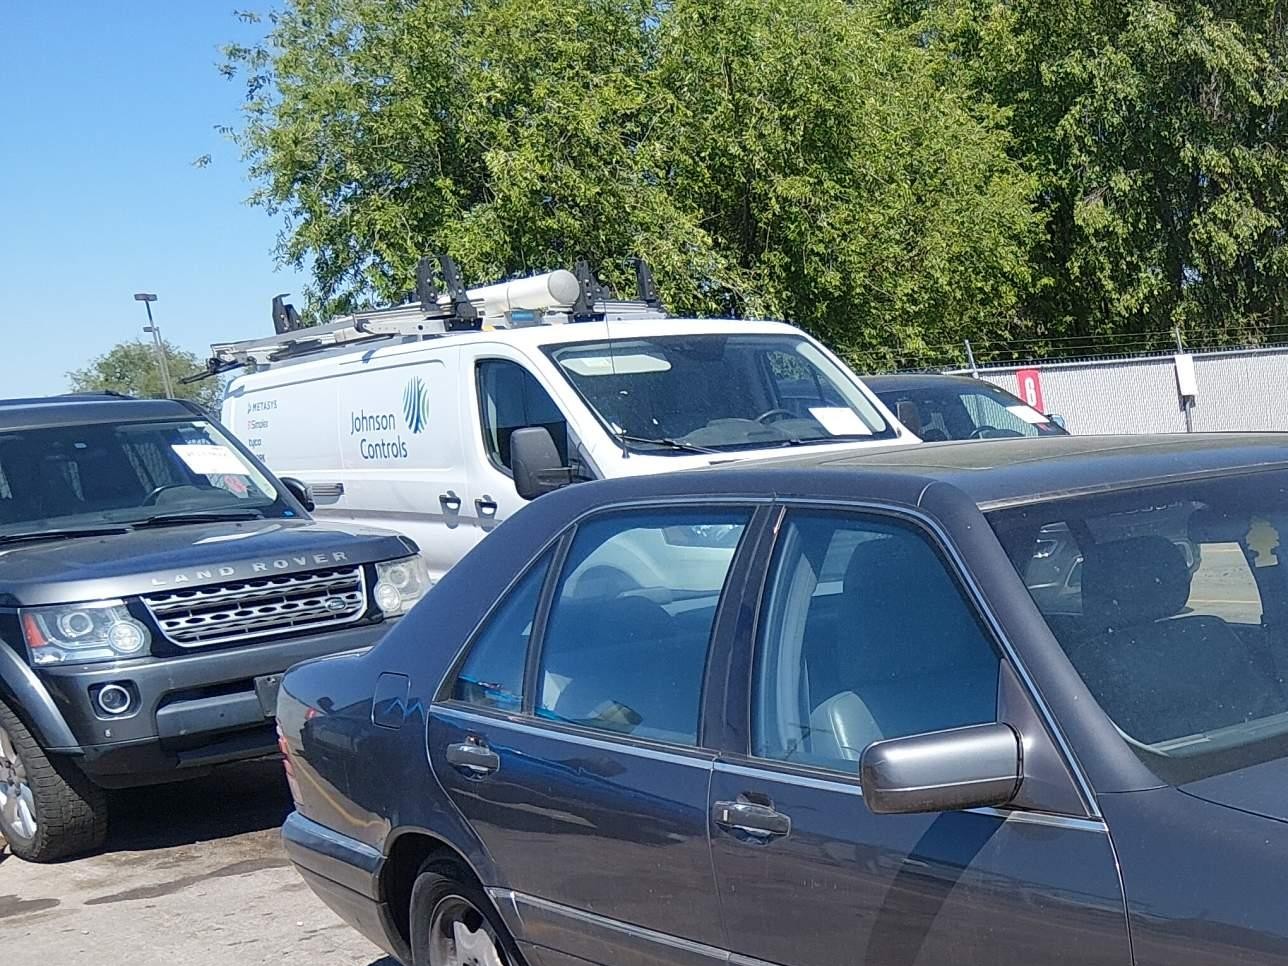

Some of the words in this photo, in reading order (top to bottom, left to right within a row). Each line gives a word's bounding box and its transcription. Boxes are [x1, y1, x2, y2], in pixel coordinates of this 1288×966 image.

[1024, 376, 1037, 407] 6
[252, 400, 278, 412] METASYS
[350, 409, 396, 436] Johnson
[360, 434, 408, 460] Controls
[151, 566, 236, 586] LAND
[251, 551, 349, 573] ROVER
